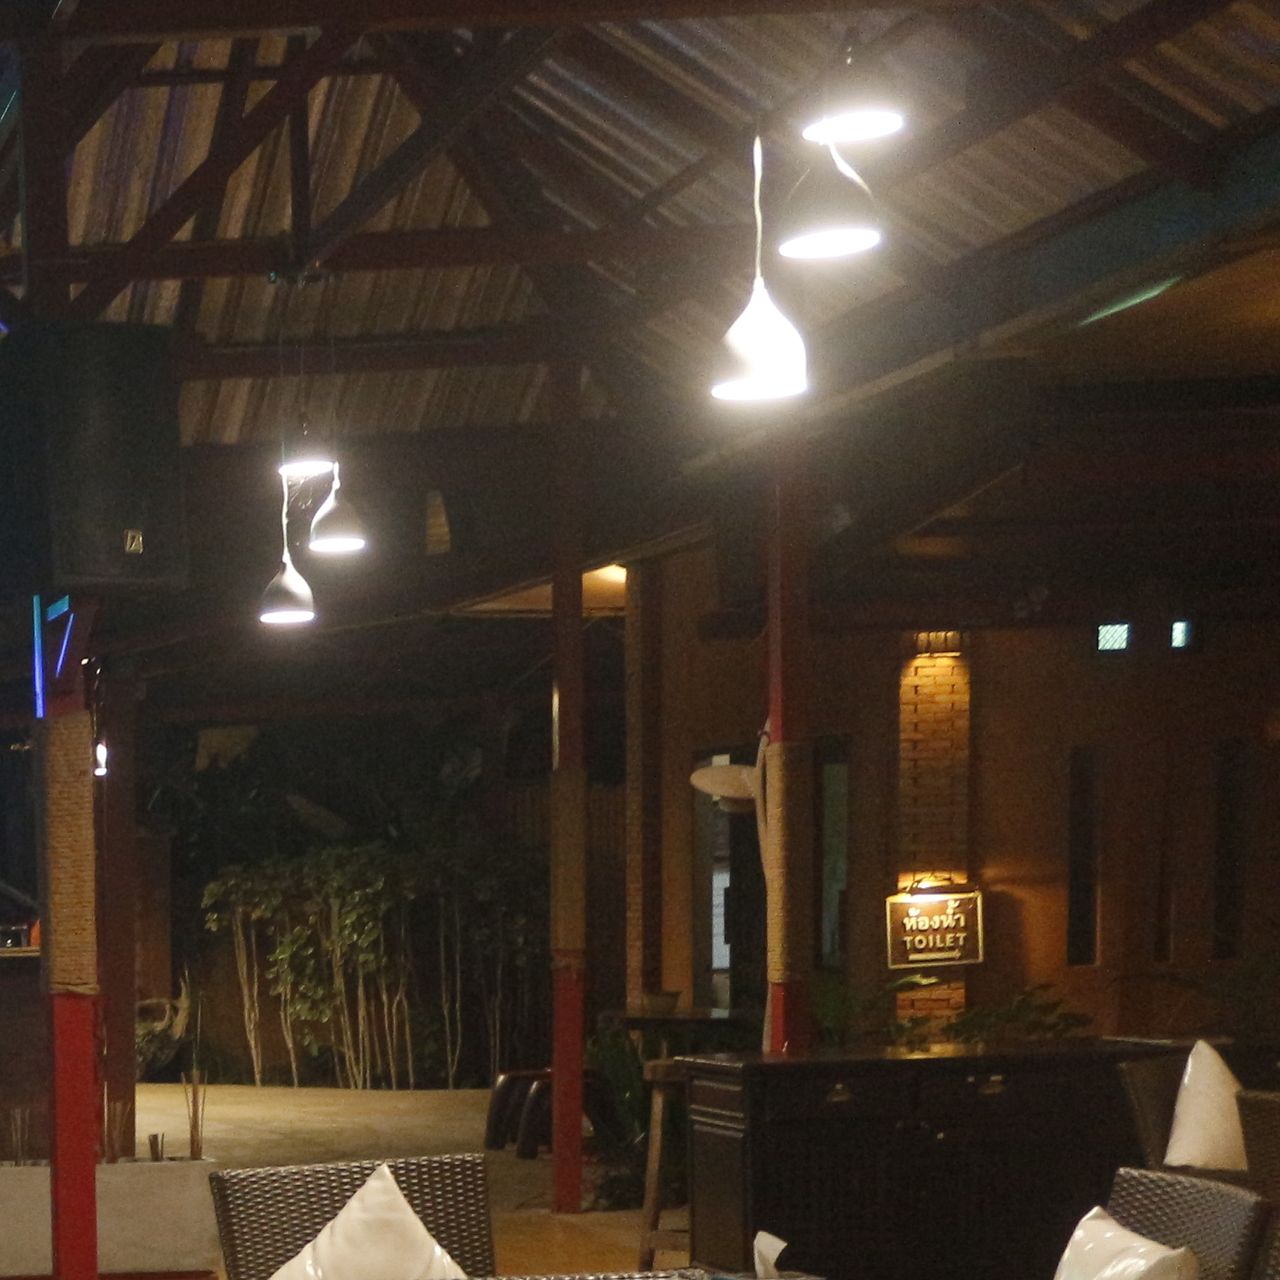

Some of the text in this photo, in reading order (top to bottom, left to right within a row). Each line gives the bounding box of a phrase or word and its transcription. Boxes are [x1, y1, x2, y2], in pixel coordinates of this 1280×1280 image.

[902, 899, 966, 931] ห้องน้ำ
[902, 932, 967, 950] TOILET
